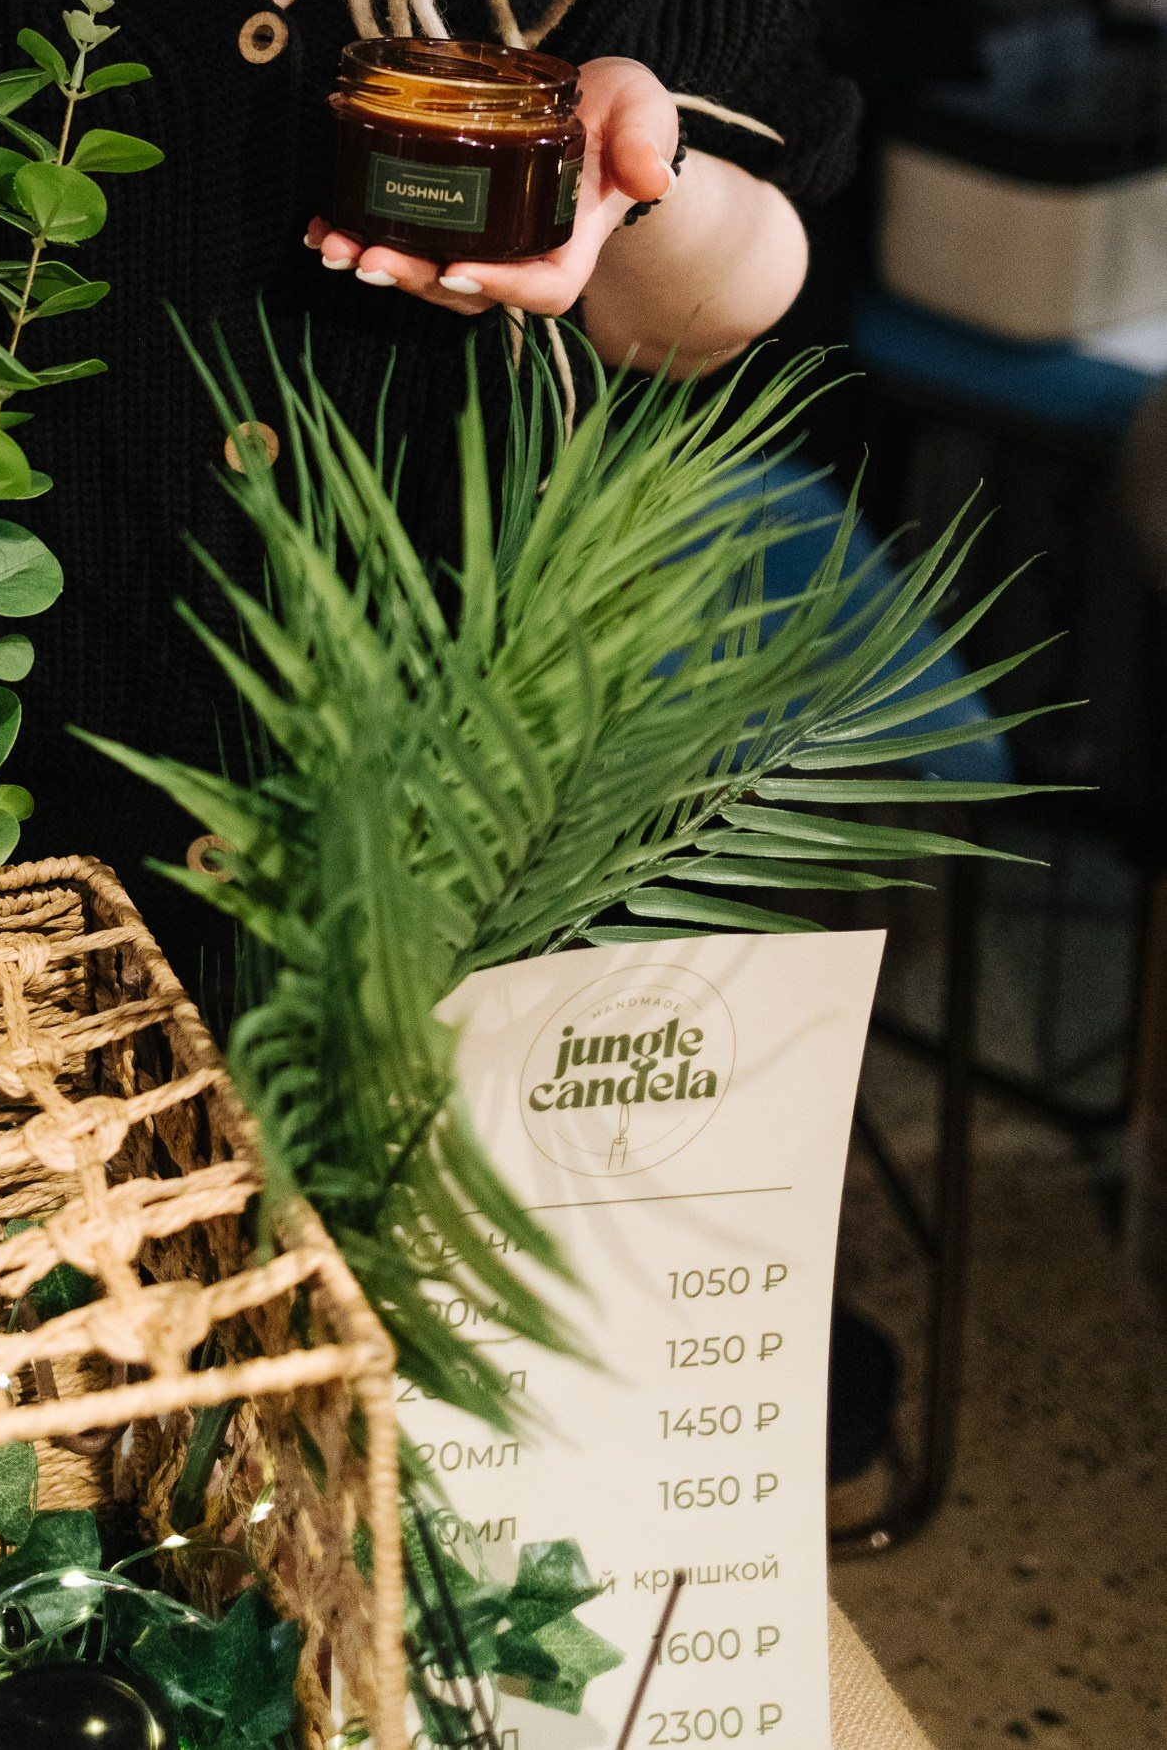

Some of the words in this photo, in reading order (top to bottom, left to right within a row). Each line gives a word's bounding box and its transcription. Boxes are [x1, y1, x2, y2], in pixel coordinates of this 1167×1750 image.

[385, 180, 464, 204] DUSHNILA
[592, 997, 682, 1020] HANDMADE
[553, 1017, 704, 1079] jungle
[529, 1058, 718, 1112] candela
[668, 1266, 750, 1300] 1050
[762, 1263, 788, 1292] ₽
[666, 1335, 746, 1368] 1250
[758, 1332, 783, 1361] ₽
[659, 1404, 742, 1439] 1450
[754, 1402, 780, 1432] ₽
[658, 1475, 740, 1511] 1650
[753, 1472, 779, 1503] ₽
[754, 1625, 780, 1658] ₽
[648, 1706, 744, 1746] 2300
[756, 1703, 783, 1736] ₽
